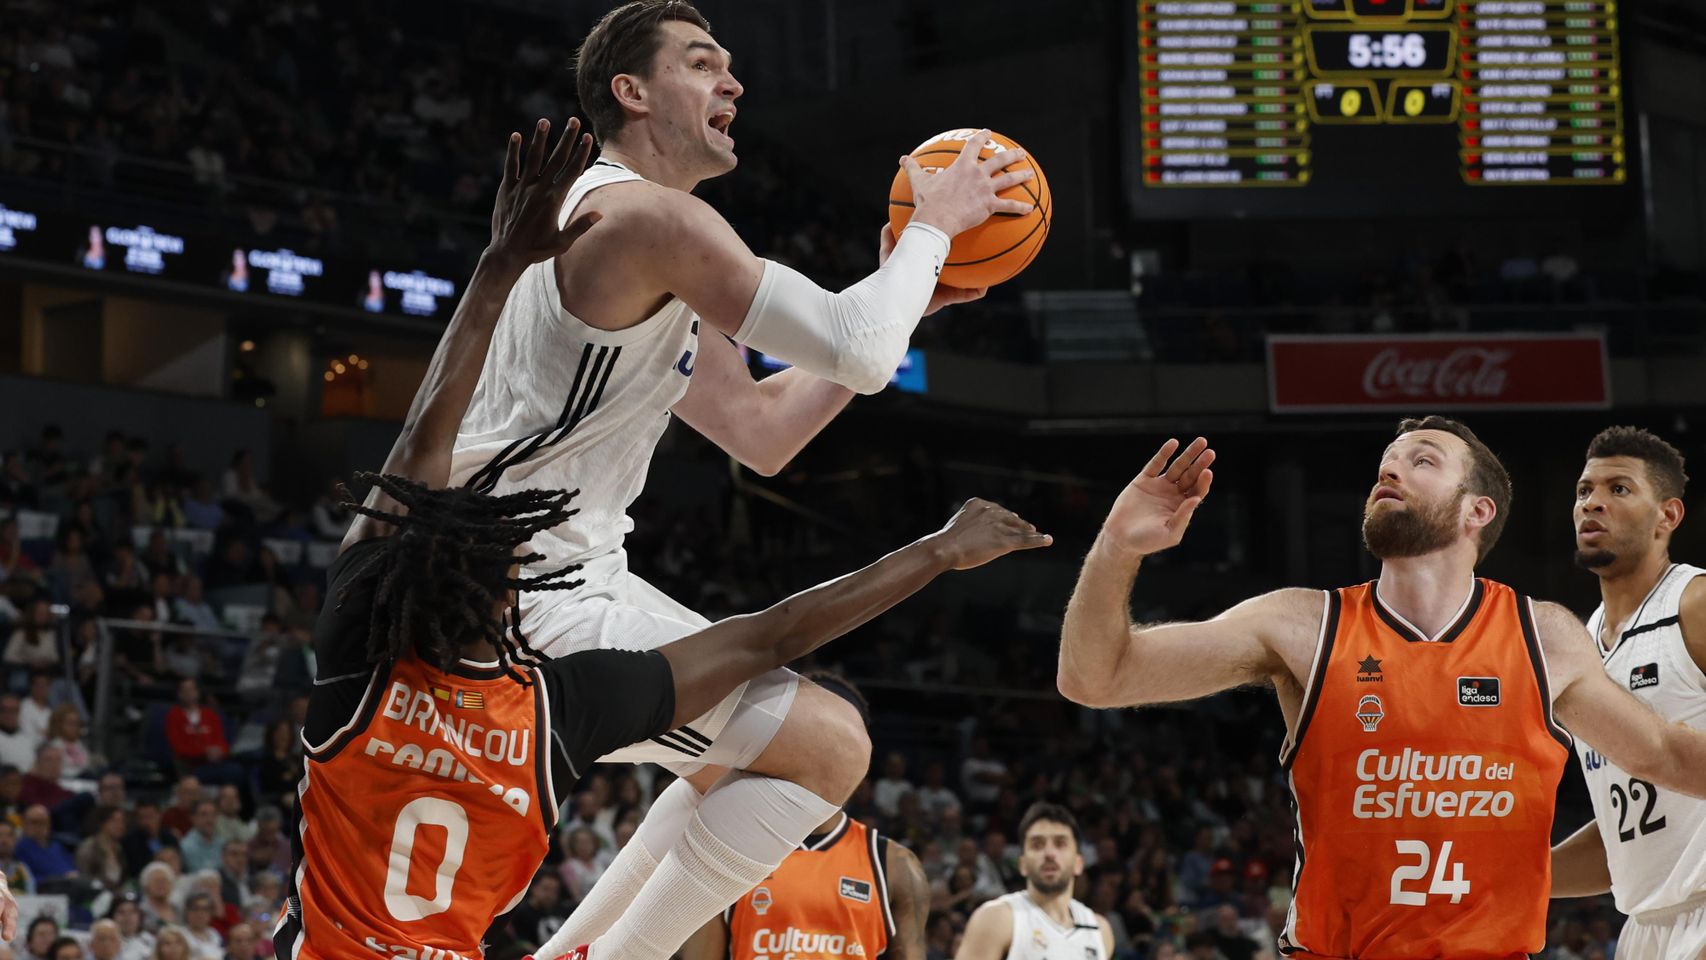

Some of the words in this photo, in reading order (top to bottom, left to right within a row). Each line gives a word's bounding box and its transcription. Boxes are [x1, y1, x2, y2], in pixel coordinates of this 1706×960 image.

[1348, 33, 1426, 68] 5:56
[1340, 89, 1361, 117] 0
[1404, 89, 1425, 117] 0
[1461, 685, 1478, 696] liga
[1461, 694, 1497, 703] endesa
[1356, 747, 1484, 782] Cultura
[1485, 762, 1515, 781] del
[1352, 782, 1514, 819] Esfuerzo
[1610, 777, 1666, 843] 22
[384, 796, 469, 922] 0
[1389, 840, 1471, 906] 24
[752, 927, 846, 955] Cultura
